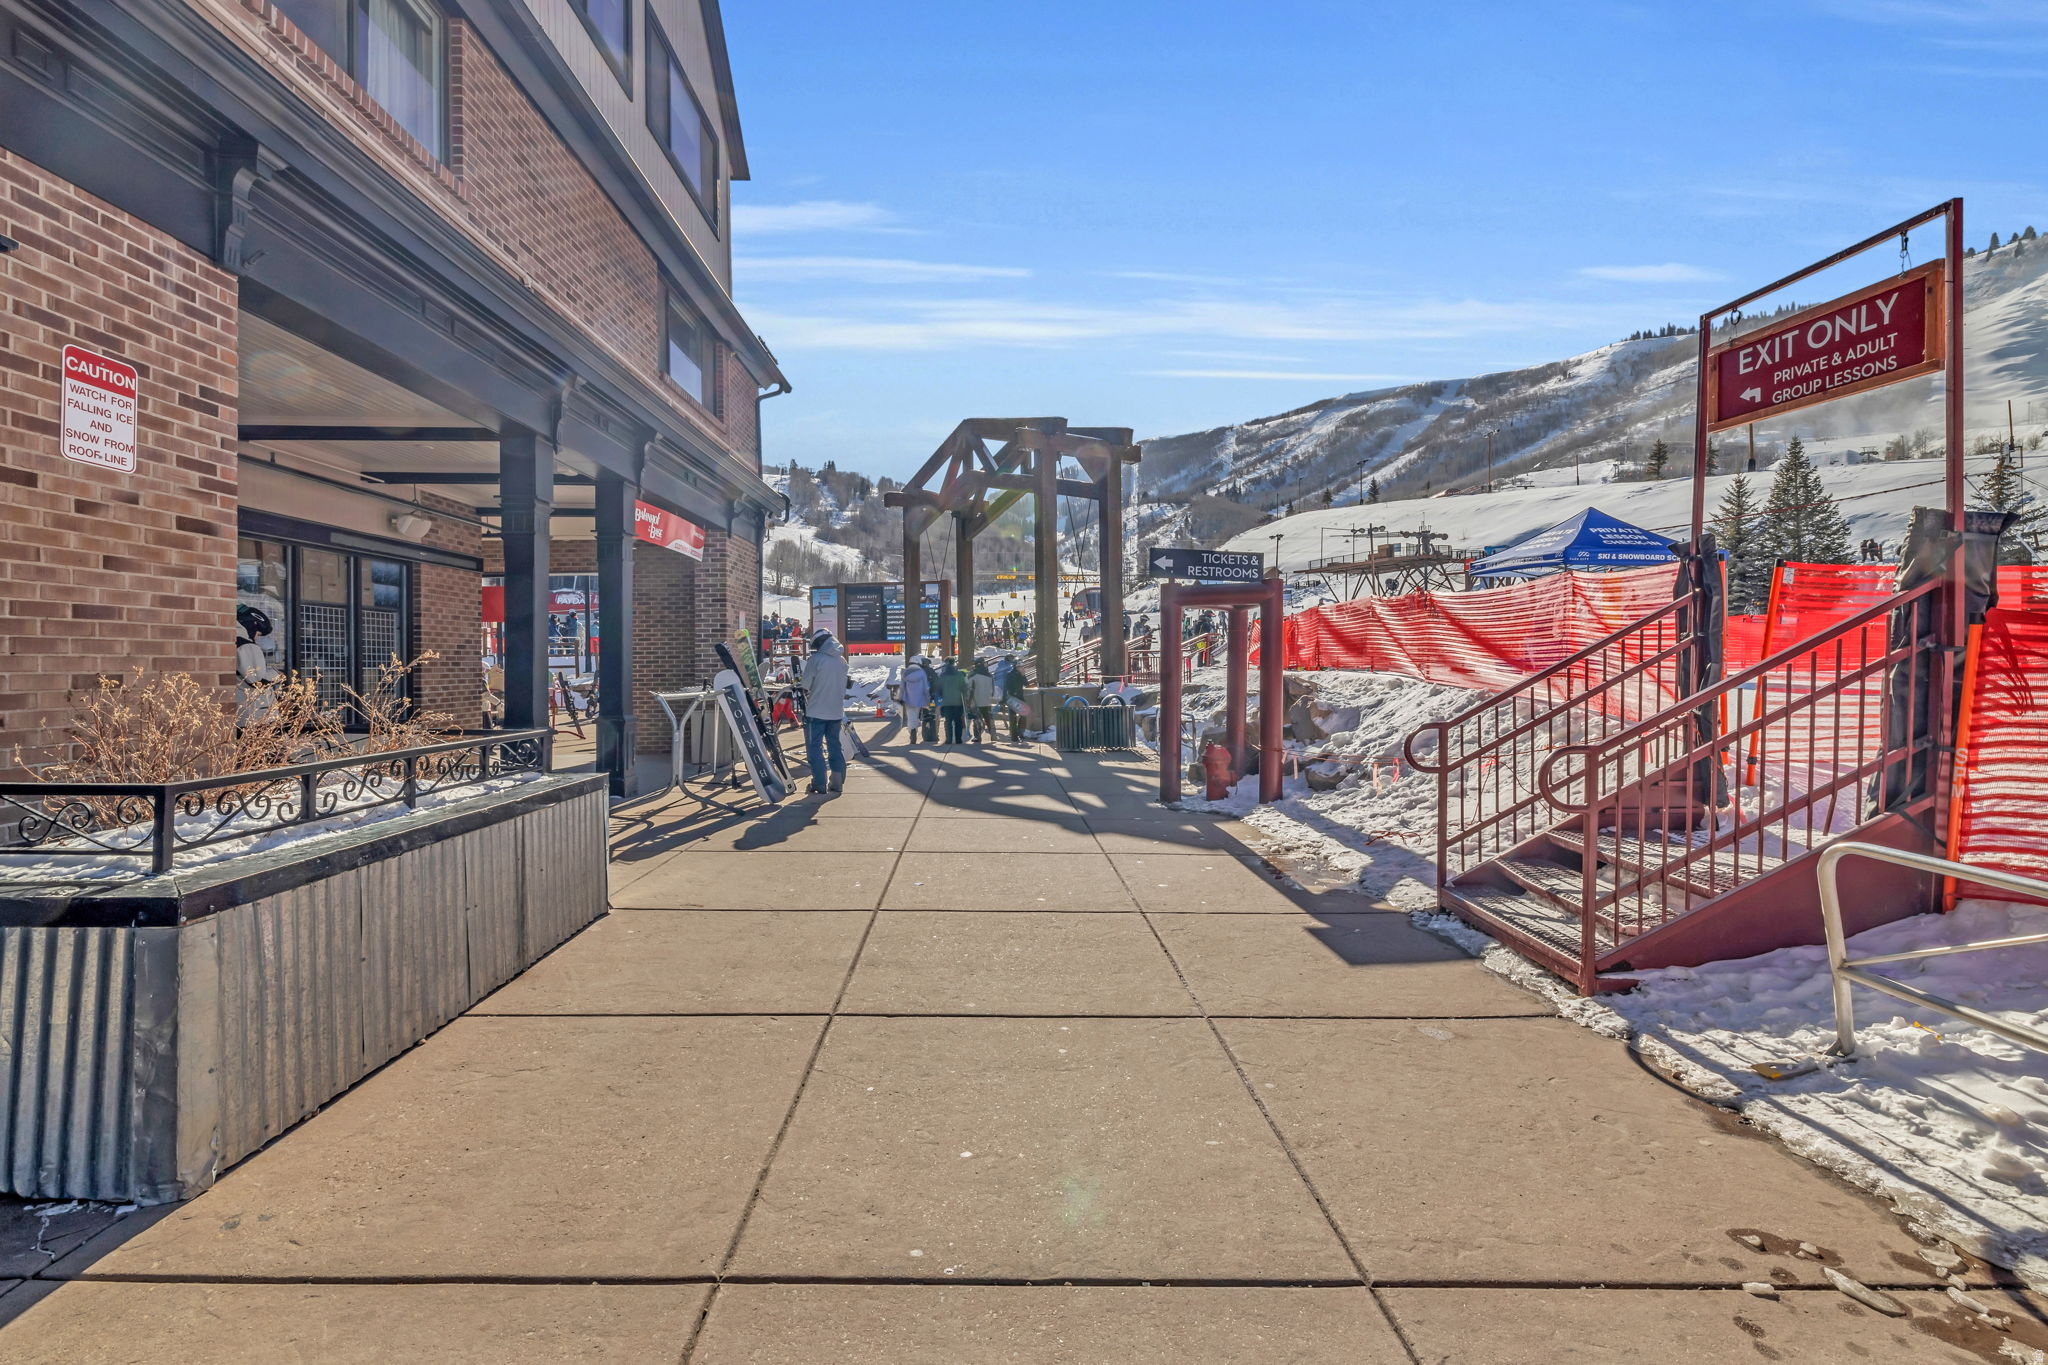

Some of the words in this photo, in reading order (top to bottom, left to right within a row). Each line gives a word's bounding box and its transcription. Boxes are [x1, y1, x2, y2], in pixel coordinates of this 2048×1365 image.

[1739, 330, 1799, 375] EXIT
[1806, 292, 1899, 349] ONLY
[1774, 358, 1829, 384] PRIVATE
[1831, 352, 1842, 366] &
[1845, 332, 1898, 362] ADULT
[66, 356, 135, 391] CAUTION
[1772, 379, 1822, 404] GROUP
[1826, 355, 1898, 389] LESSONS
[69, 383, 107, 402] WATCH
[111, 396, 132, 410] FOR
[67, 398, 112, 419] FALLING
[116, 412, 133, 425] ICE
[89, 420, 112, 433] AND
[65, 428, 100, 444] SNOW
[104, 438, 134, 454] FROM
[69, 444, 101, 459] ROOF
[104, 453, 128, 466] LINE
[1202, 553, 1248, 565] TICKETS
[1251, 556, 1259, 566] &
[1618, 553, 1665, 561] SNOWBOARD
[1188, 566, 1259, 579] RESTROOMS
[557, 596, 587, 605] PAYDA
